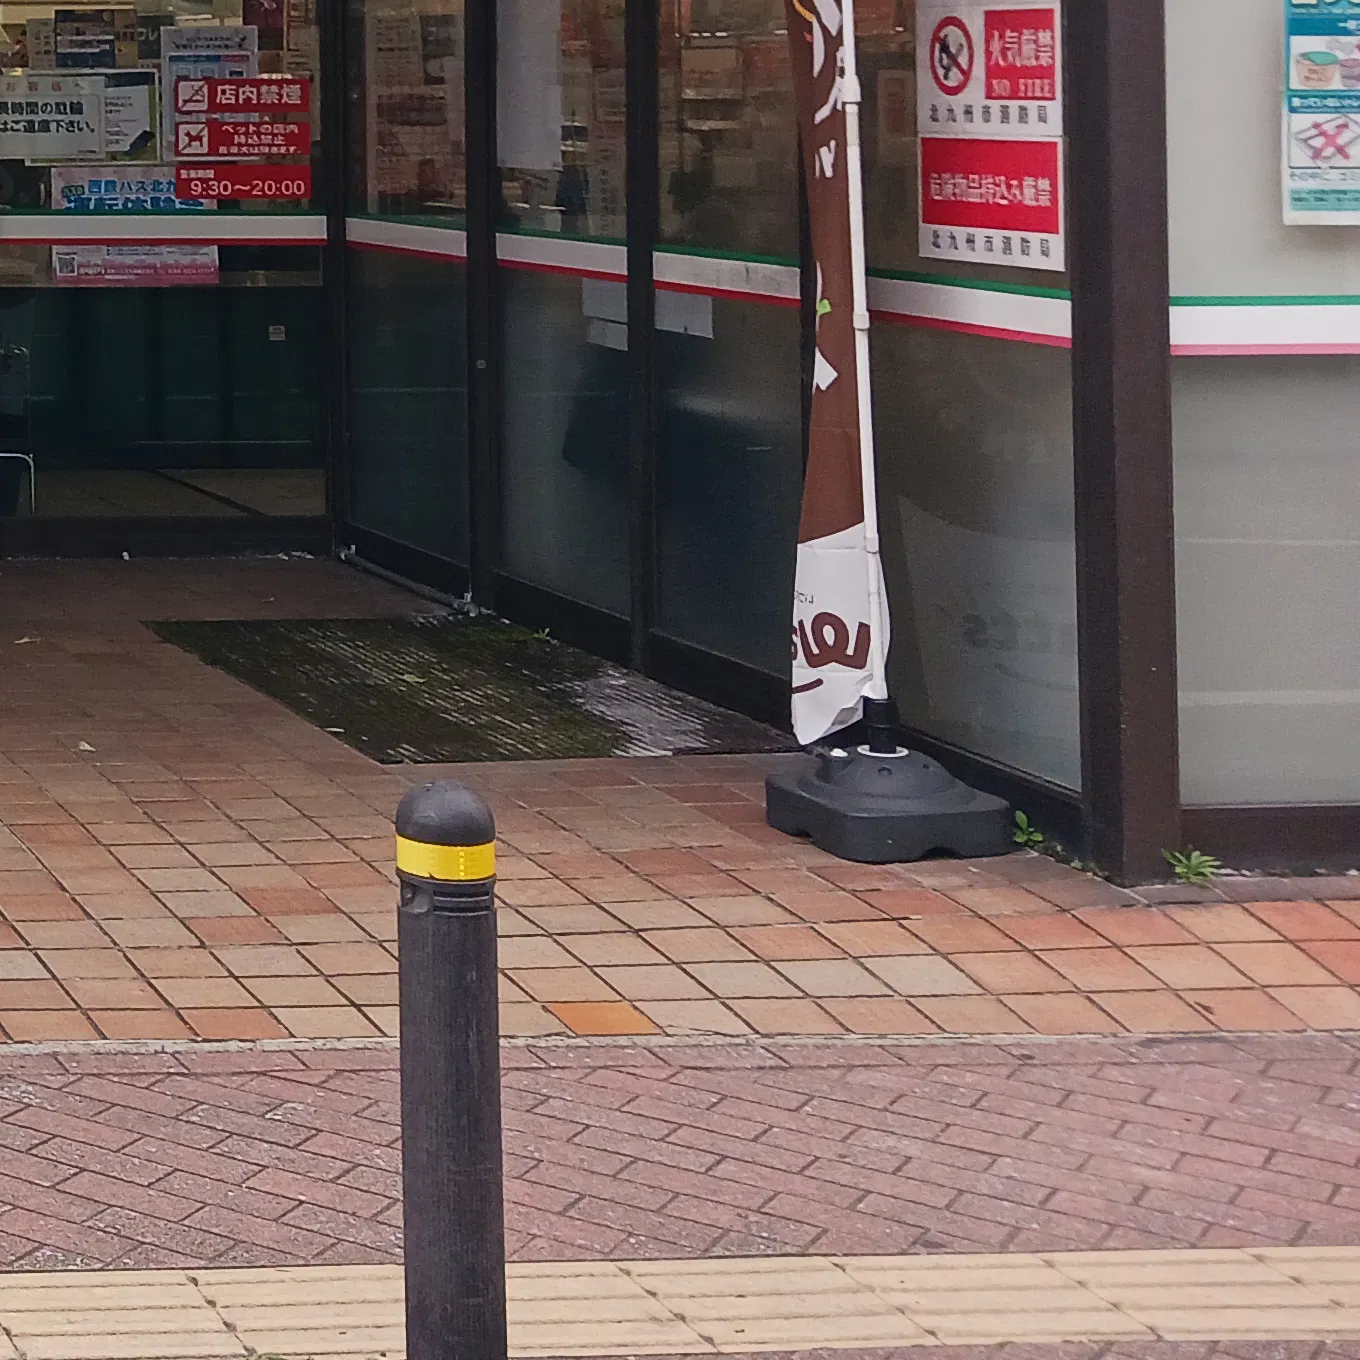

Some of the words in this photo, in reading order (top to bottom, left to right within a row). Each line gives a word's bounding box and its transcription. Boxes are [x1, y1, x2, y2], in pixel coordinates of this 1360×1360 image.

[988, 27, 1054, 68] 火気厳禁
[216, 83, 302, 105] 店内禁煙
[990, 78, 1012, 98] NO
